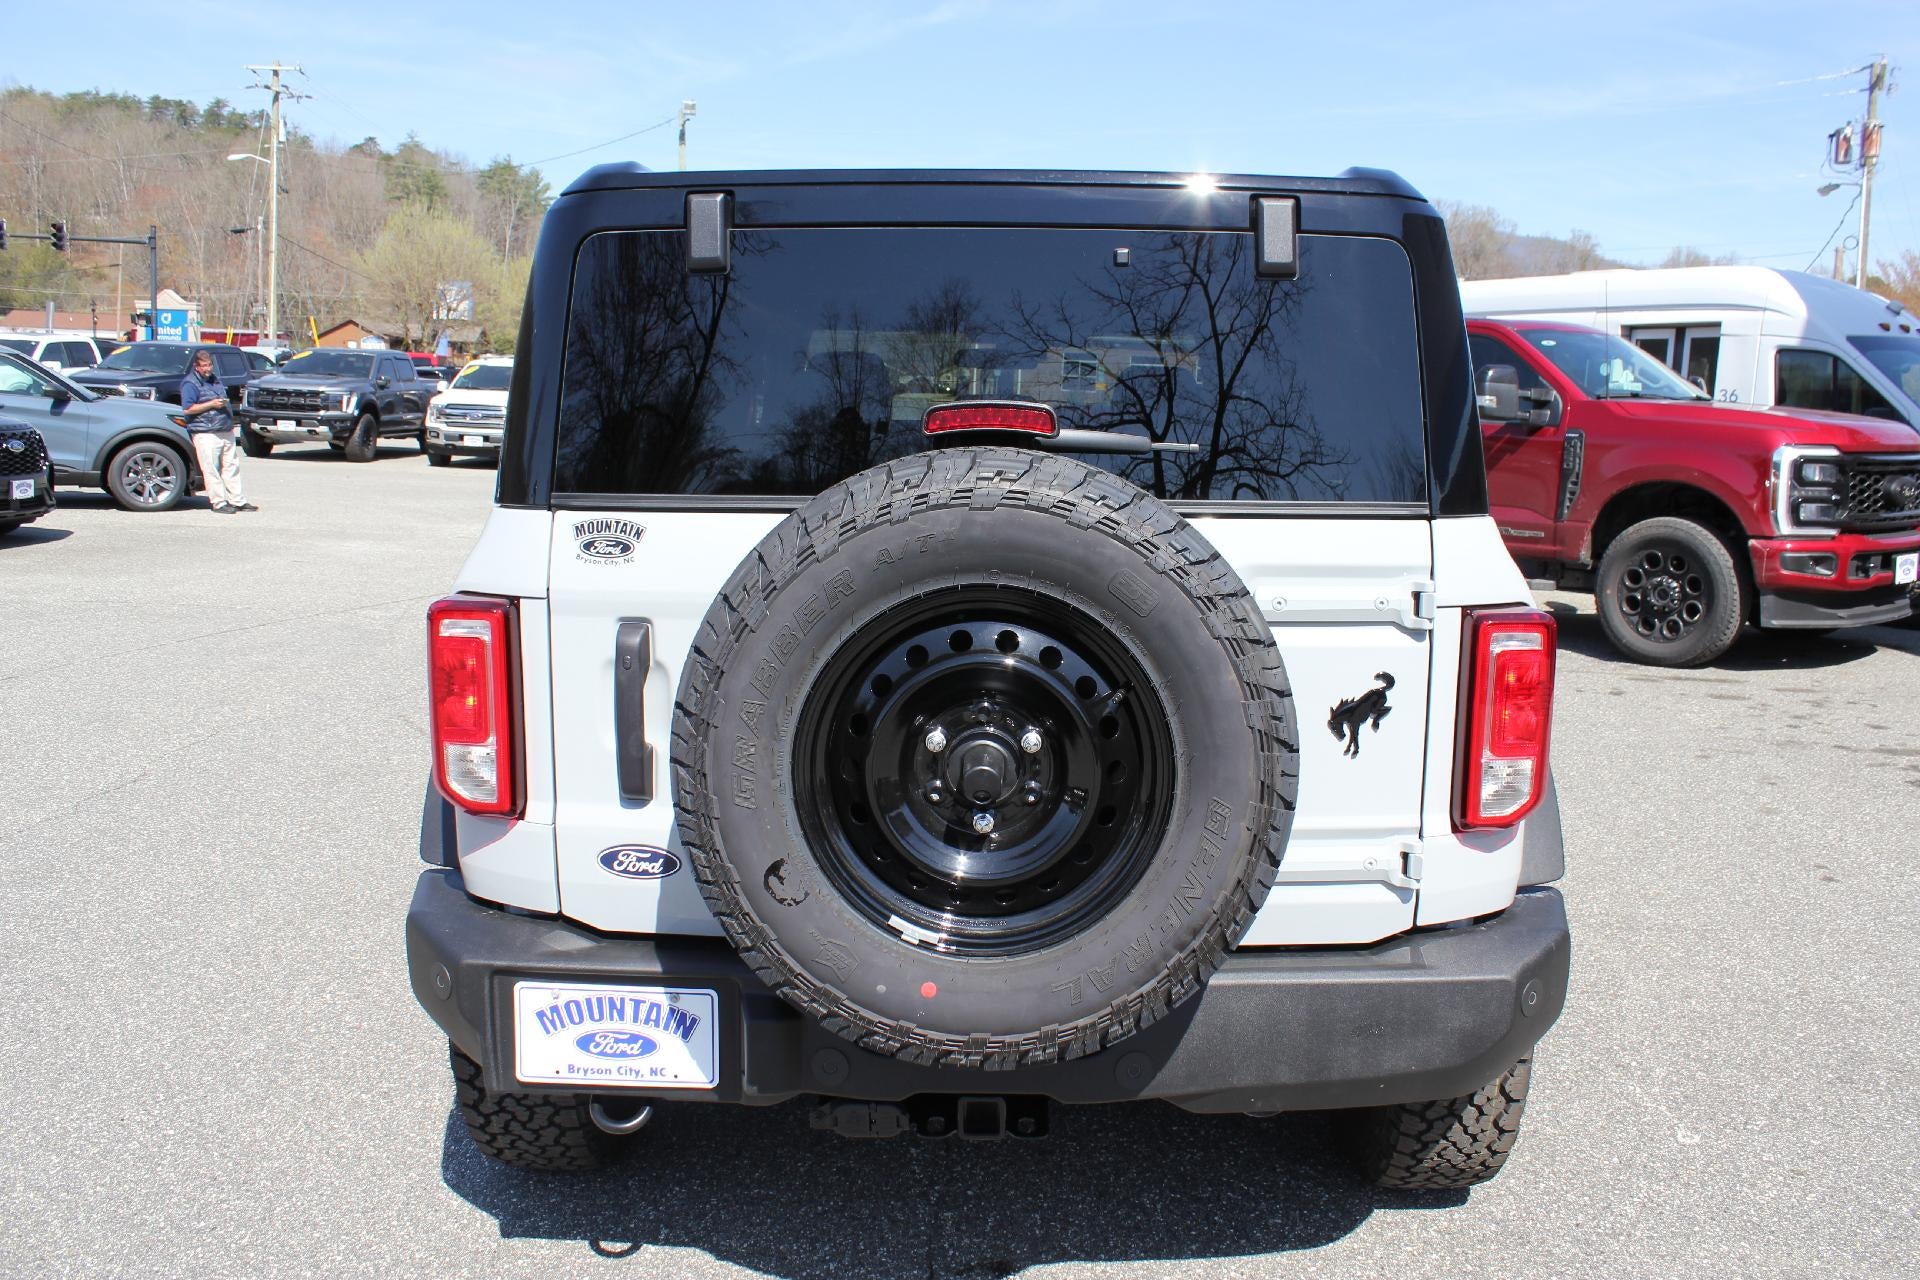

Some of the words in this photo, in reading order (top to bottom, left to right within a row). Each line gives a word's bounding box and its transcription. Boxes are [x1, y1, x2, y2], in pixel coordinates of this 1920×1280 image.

[156, 325, 182, 335] nited
[1720, 389, 1738, 403] 36
[573, 519, 646, 541] MOUNTAIN
[590, 541, 624, 555] Ford
[576, 554, 602, 565] Bryson
[623, 556, 636, 565] NC
[730, 569, 857, 810] GRABBER
[613, 850, 665, 873] Ford
[1051, 796, 1233, 1006] GENERAL
[535, 996, 701, 1043] MOUNTAIN
[588, 1033, 643, 1055] Ford
[567, 1063, 612, 1077] Bryson
[617, 1065, 644, 1079] City,
[650, 1067, 667, 1078] NC
